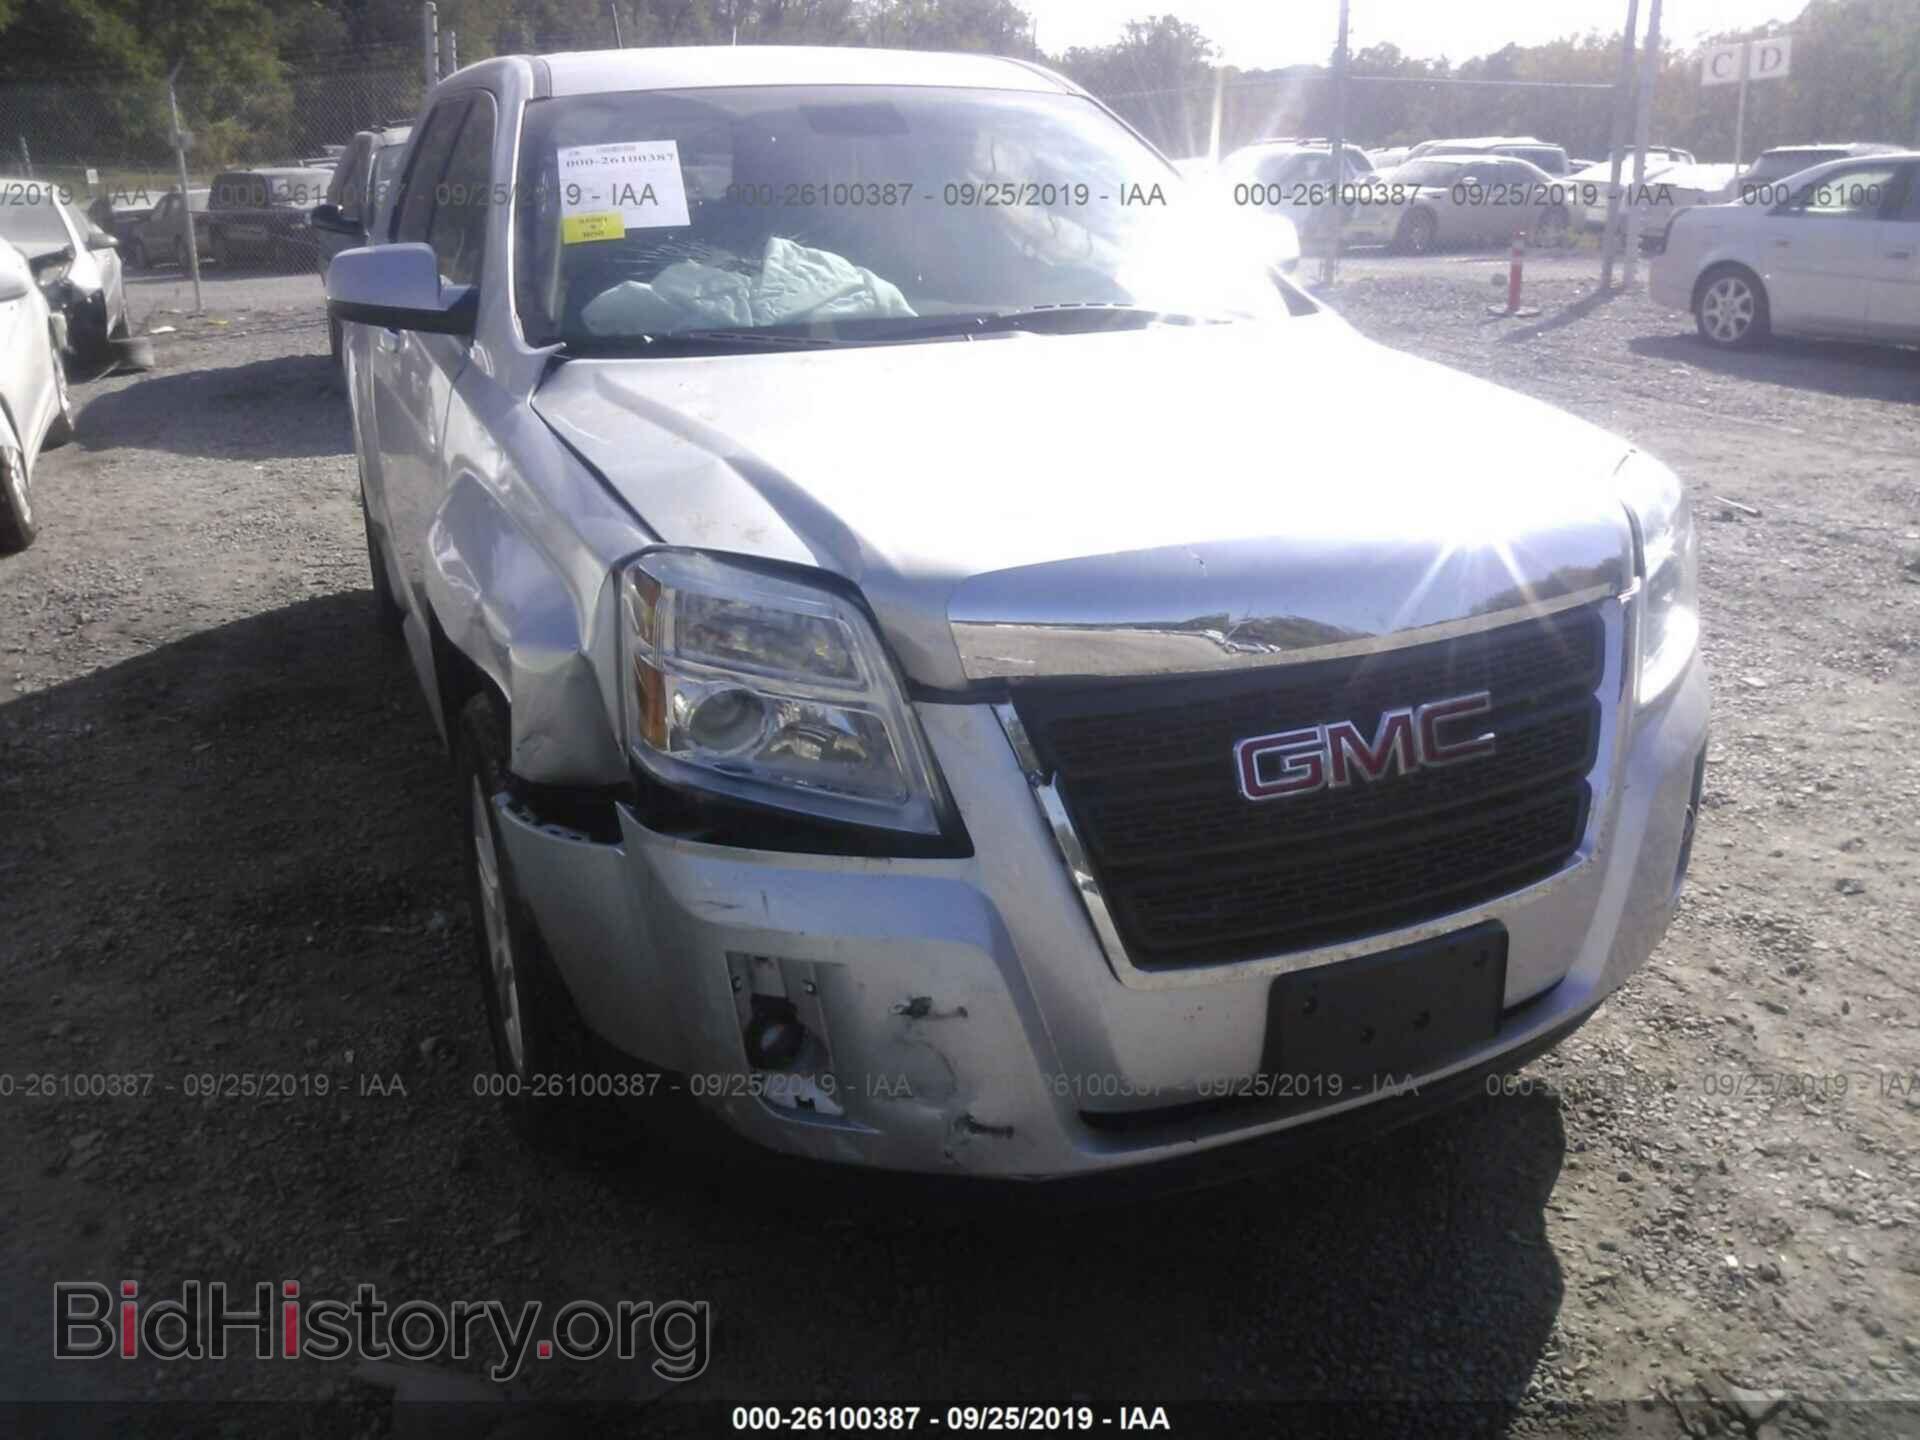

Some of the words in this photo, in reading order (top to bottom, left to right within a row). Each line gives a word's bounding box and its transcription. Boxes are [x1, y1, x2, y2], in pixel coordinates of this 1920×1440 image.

[1711, 52, 1733, 78] C
[1759, 47, 1782, 72] D
[1234, 690, 1496, 801] GMC
